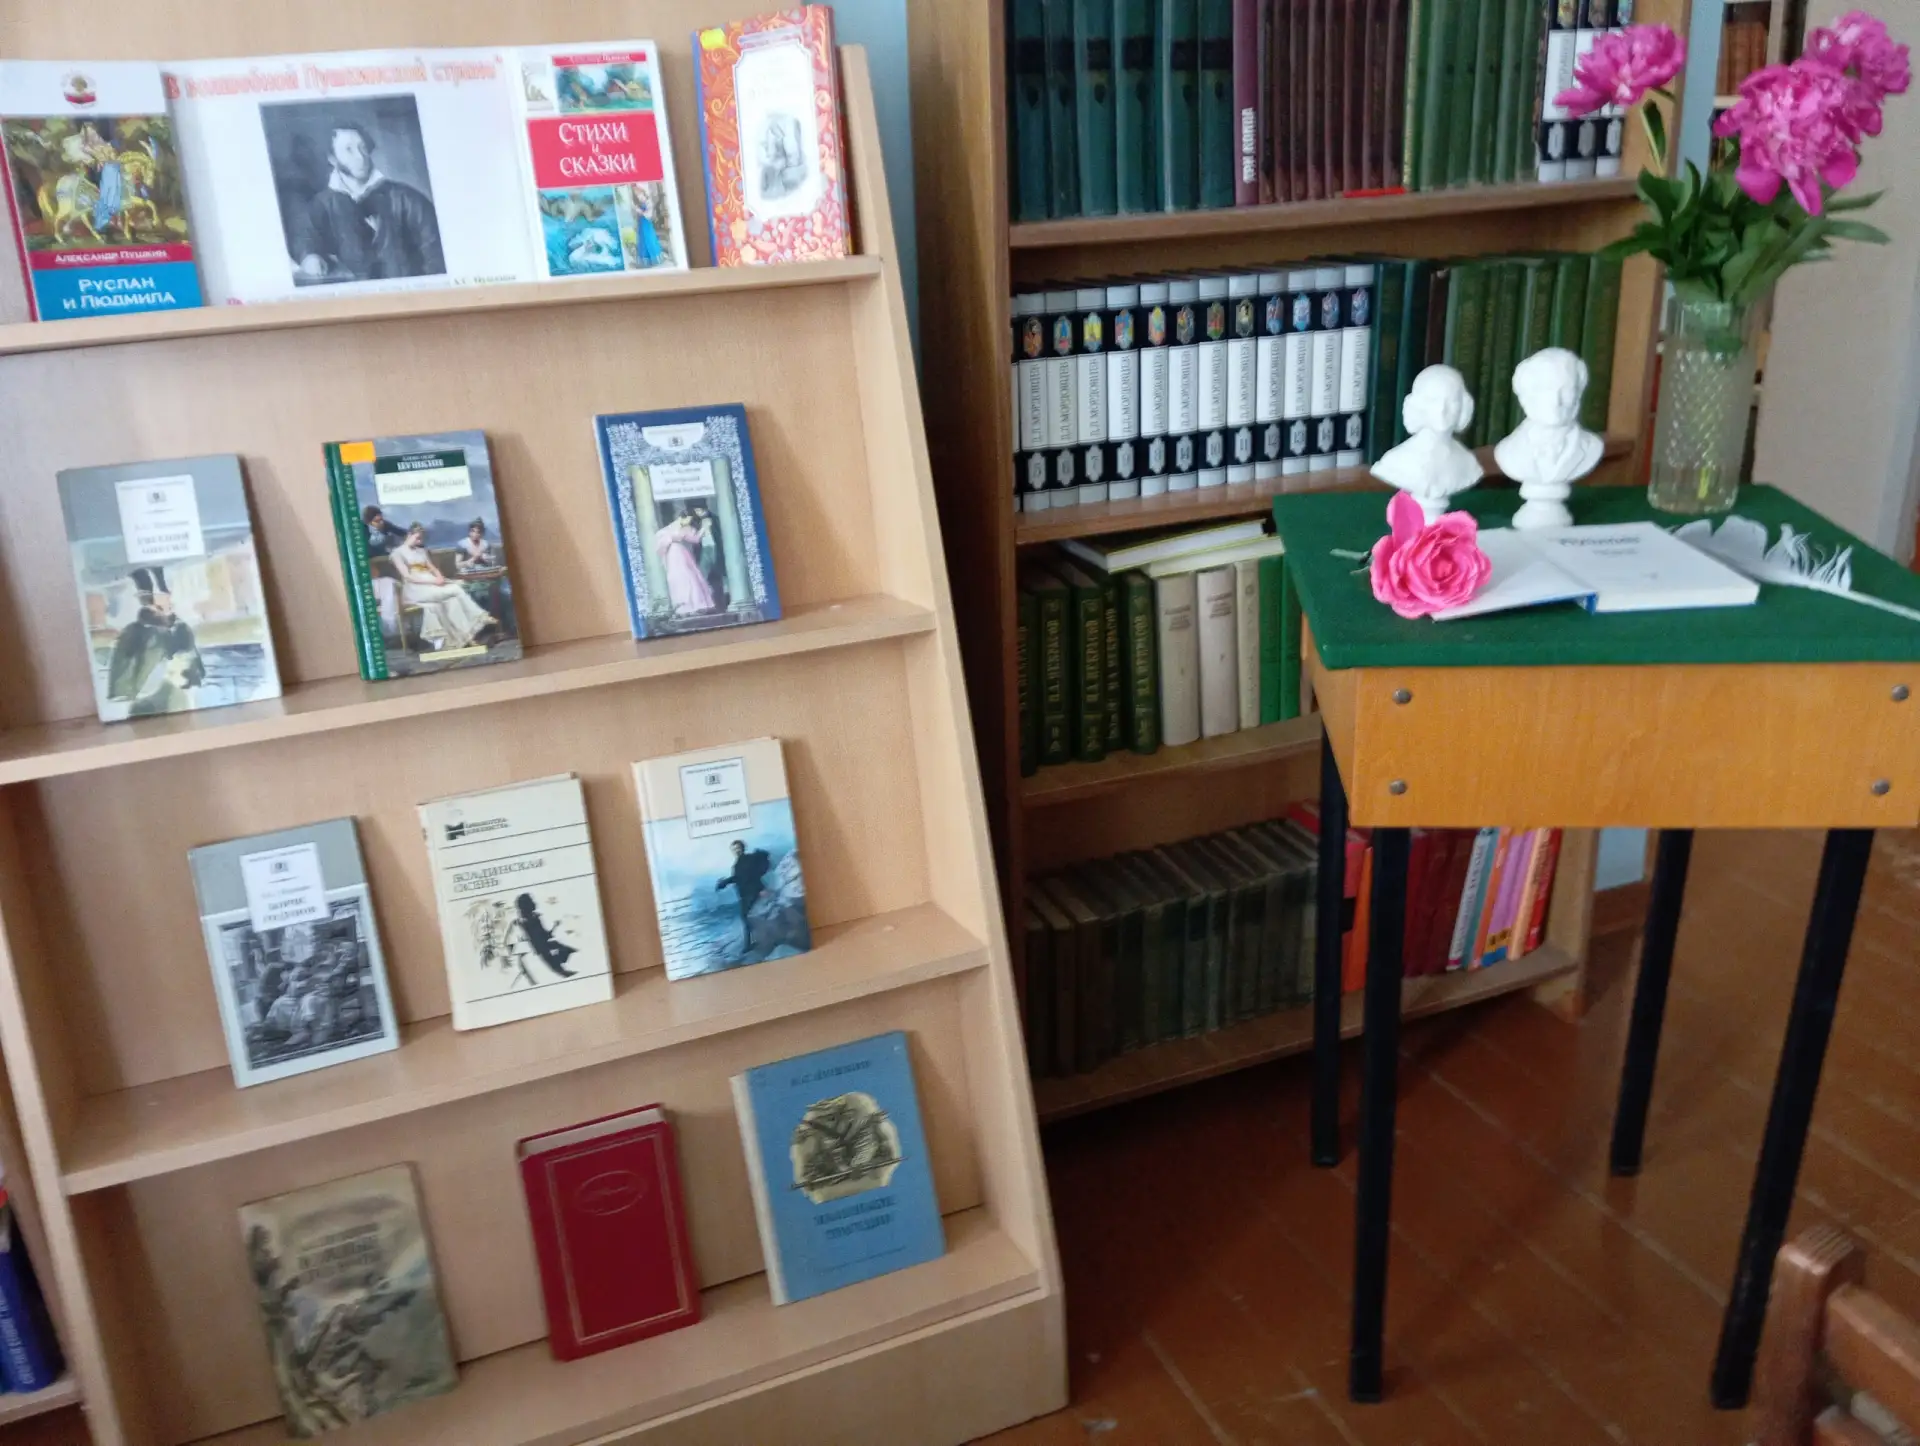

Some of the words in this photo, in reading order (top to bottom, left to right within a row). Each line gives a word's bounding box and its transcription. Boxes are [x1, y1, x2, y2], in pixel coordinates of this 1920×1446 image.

[78, 276, 156, 293] РУСЛАН
[80, 291, 177, 310] ЛЮДМИЛА
[452, 858, 545, 884] БОЛДИНСКАЯ
[453, 879, 498, 893] ОСЕНЬ
